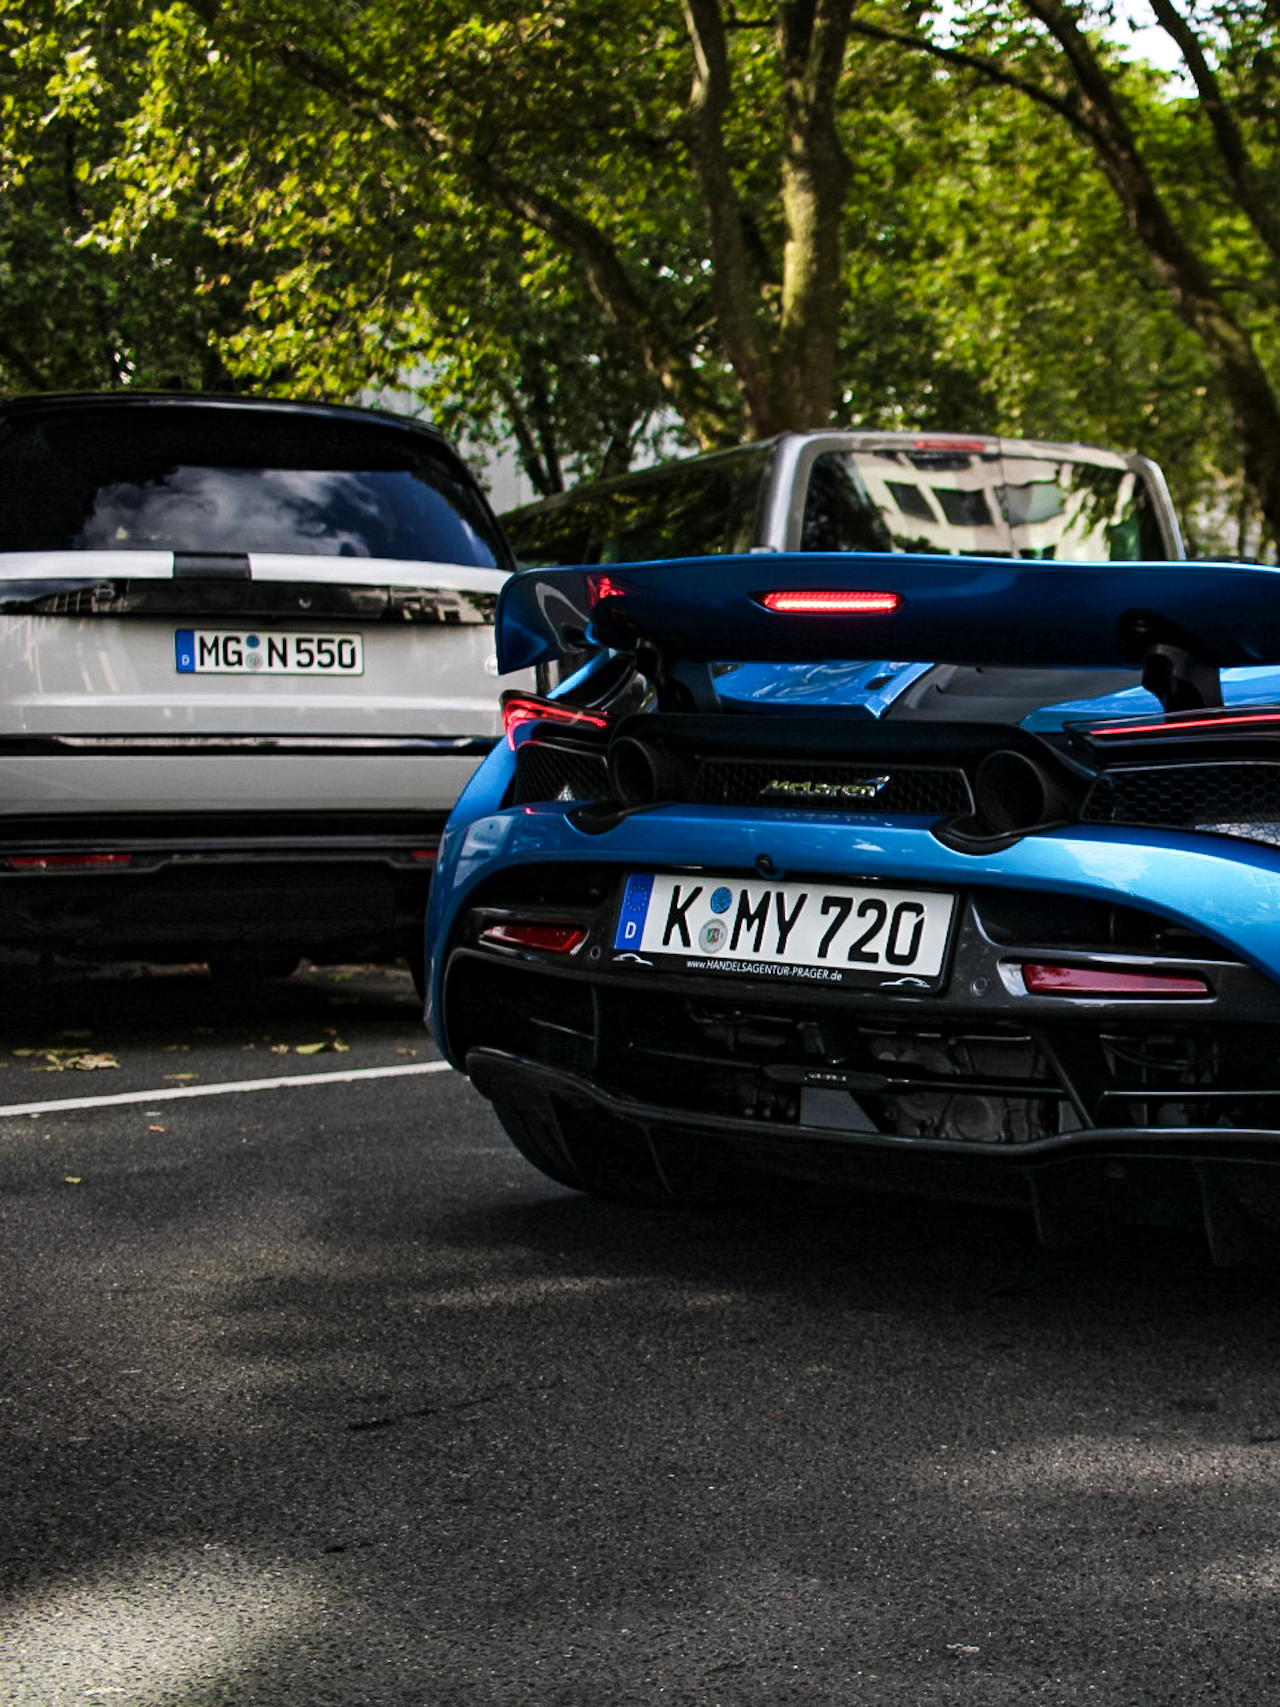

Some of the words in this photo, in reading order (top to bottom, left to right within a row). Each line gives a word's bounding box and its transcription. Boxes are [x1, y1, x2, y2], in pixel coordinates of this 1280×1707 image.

[181, 654, 190, 666] D
[199, 635, 243, 667] MG
[267, 637, 288, 668] N
[295, 638, 356, 669] 550
[624, 921, 637, 940] D
[662, 885, 703, 948] K
[729, 889, 808, 954] MY
[817, 895, 927, 966] 720
[686, 960, 843, 981] www.HANDELSAGENTUR-PRAGER.de
